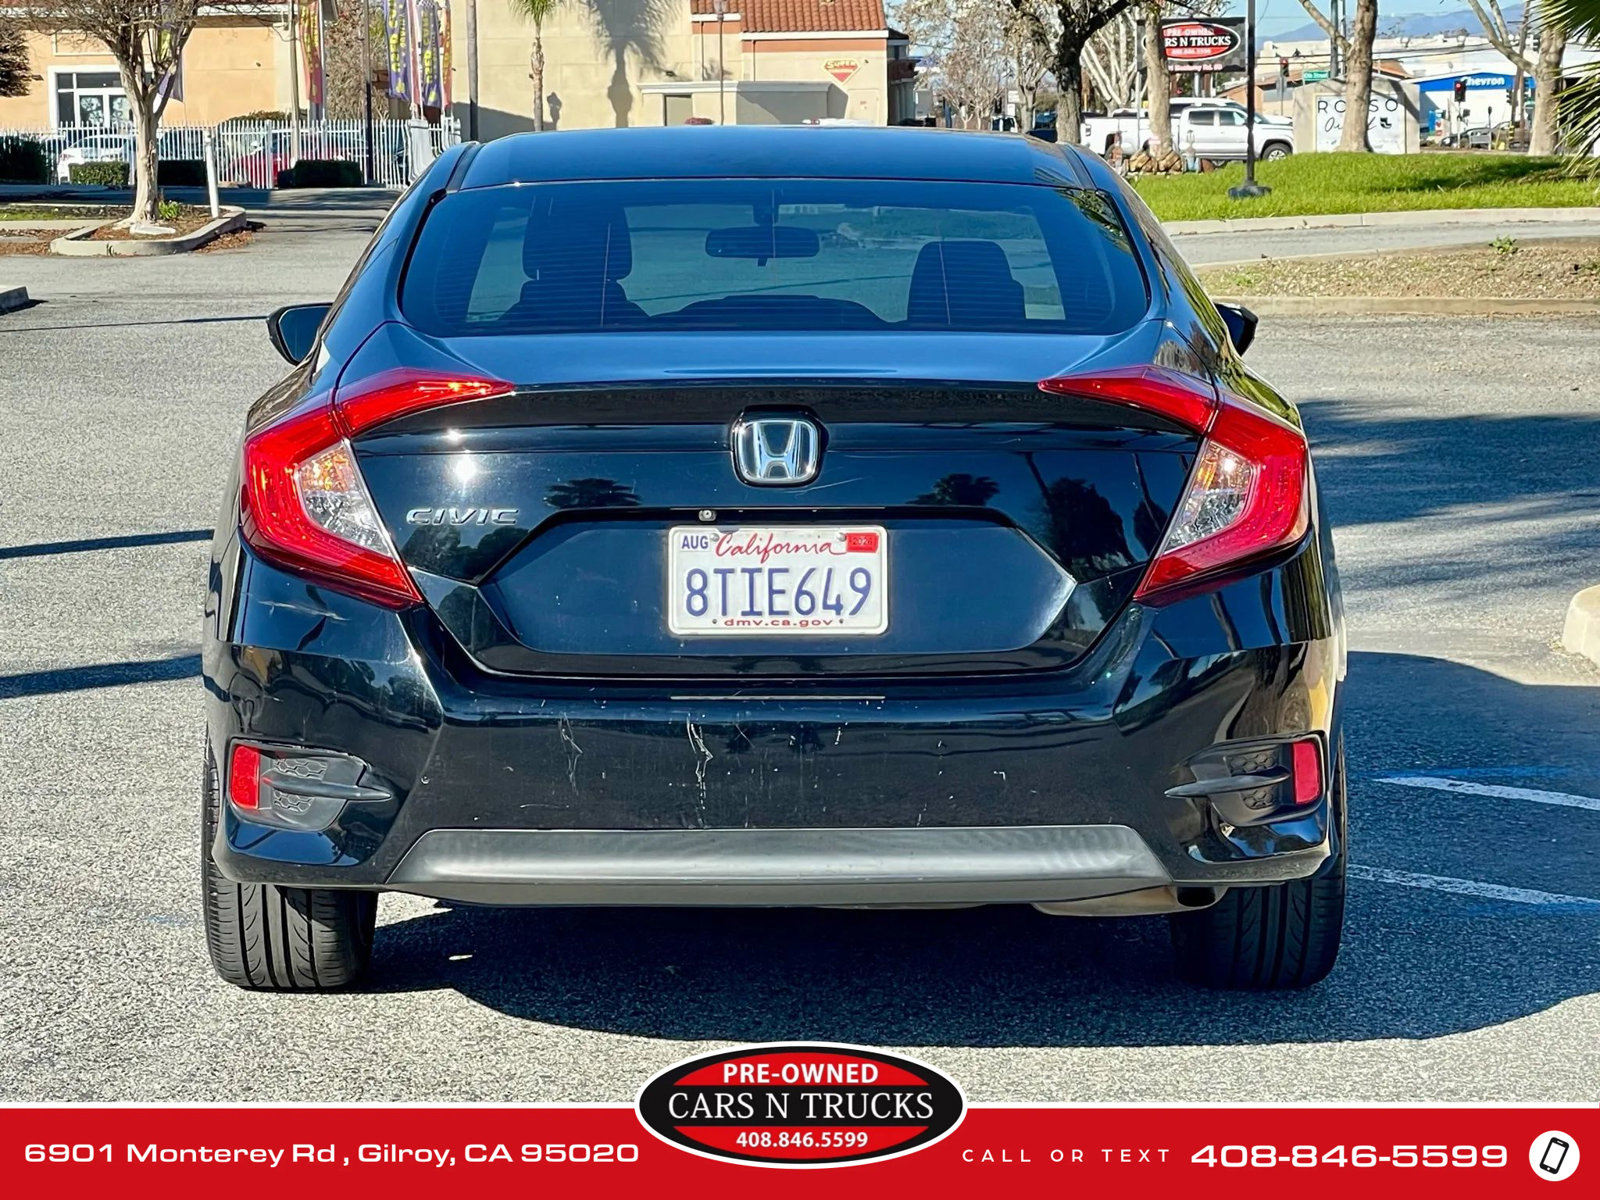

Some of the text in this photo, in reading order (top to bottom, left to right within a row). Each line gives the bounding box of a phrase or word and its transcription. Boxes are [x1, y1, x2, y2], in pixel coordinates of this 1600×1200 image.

[1165, 35, 1232, 47] RS N TRUCKS
[1318, 99, 1398, 113] ROSO
[406, 508, 519, 526] CIVIC
[681, 535, 709, 550] AUG
[715, 533, 847, 564] California
[686, 567, 872, 617] 8TIE649
[724, 618, 834, 627] dmv.ca.gov
